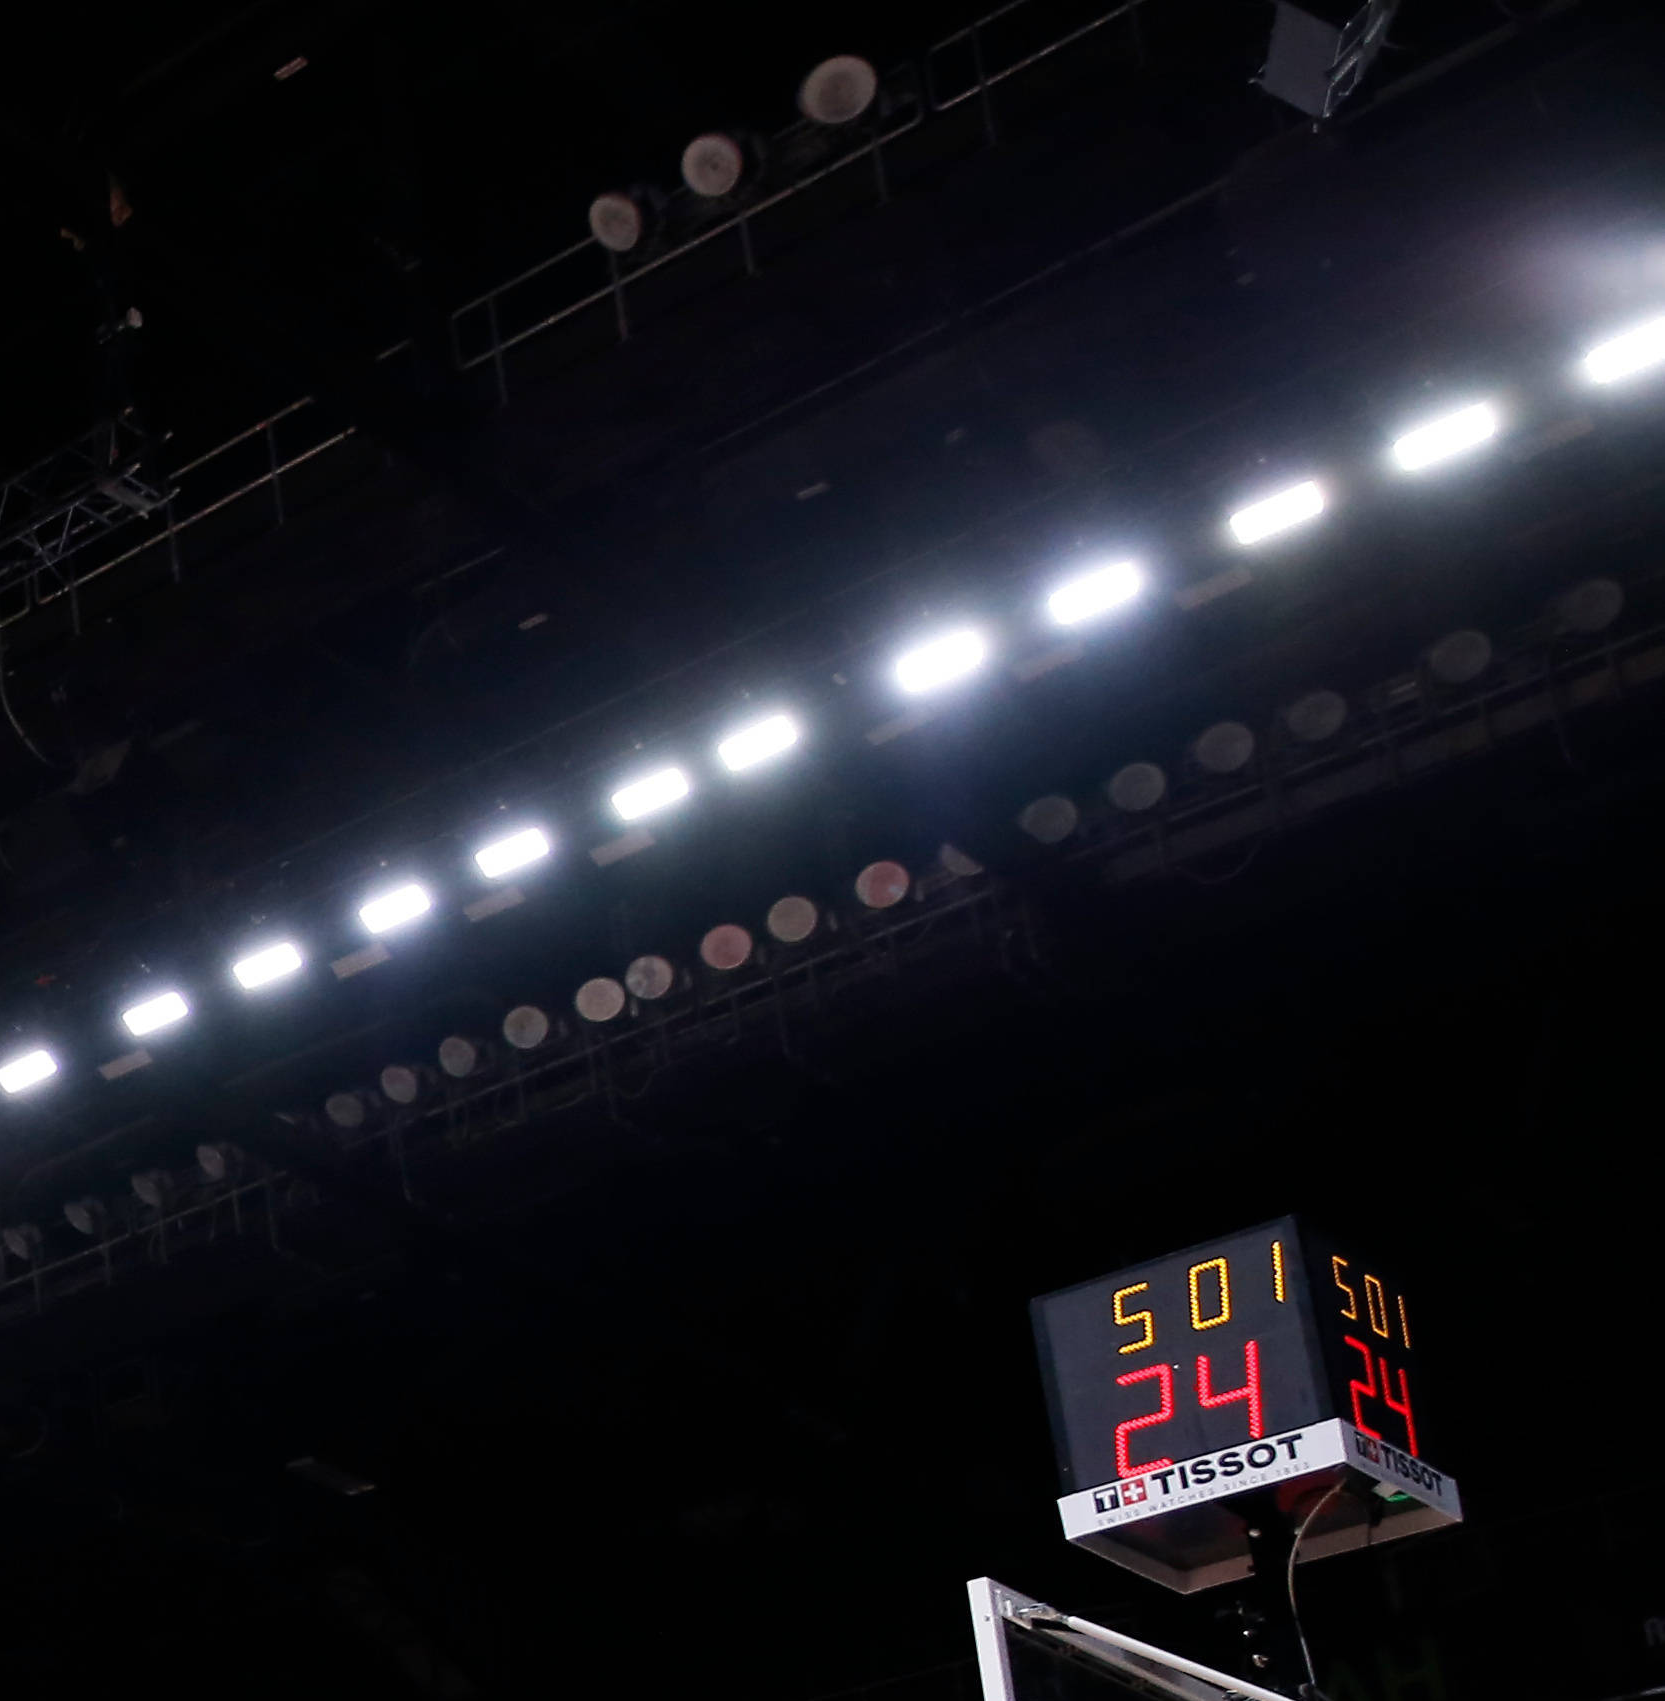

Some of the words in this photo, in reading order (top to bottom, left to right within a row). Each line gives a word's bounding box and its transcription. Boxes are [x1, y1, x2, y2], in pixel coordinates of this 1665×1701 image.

[1115, 1340, 1263, 1479] 24
[1345, 1334, 1419, 1457] 24
[1151, 1433, 1305, 1495] TISSOT
[1384, 1443, 1443, 1496] TISSOT
